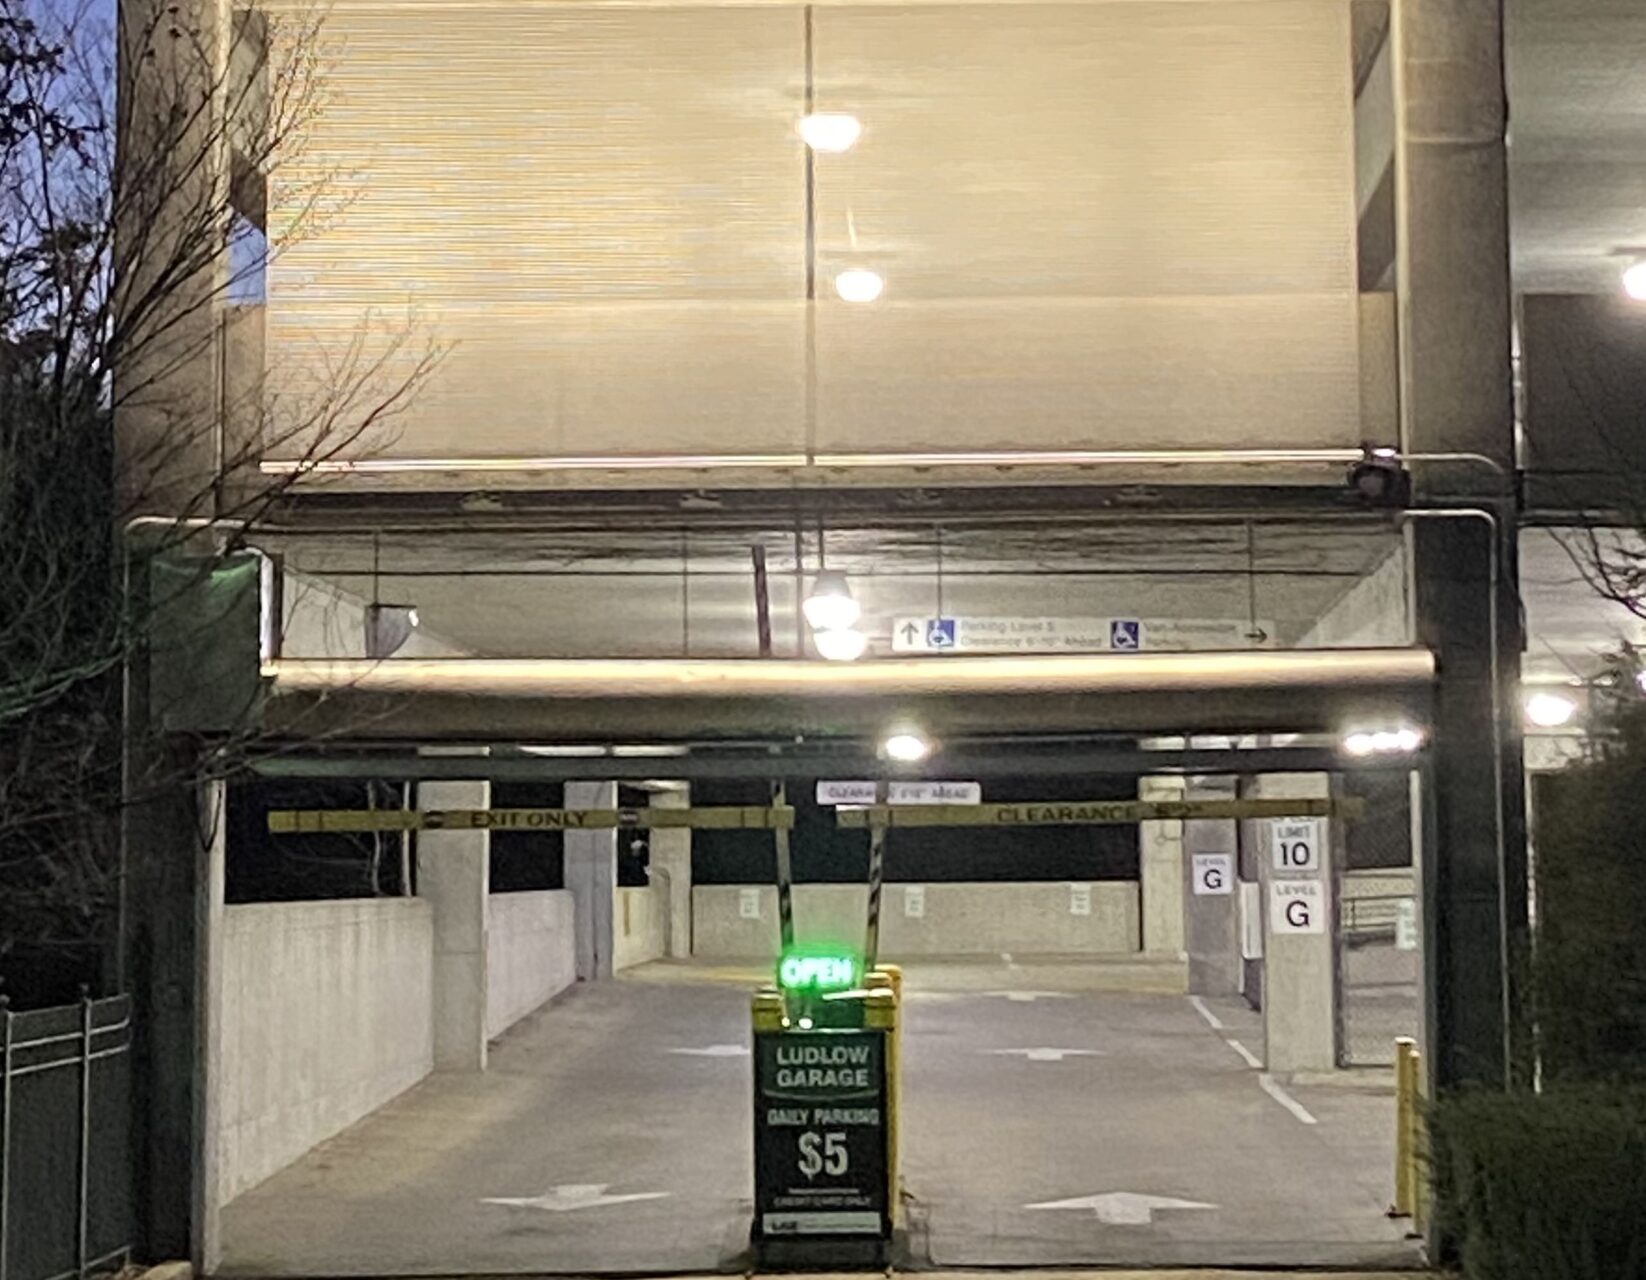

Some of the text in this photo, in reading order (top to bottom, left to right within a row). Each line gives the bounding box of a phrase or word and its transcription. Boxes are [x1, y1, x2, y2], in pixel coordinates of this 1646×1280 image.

[471, 811, 588, 827] EXIT ONLY
[997, 805, 1134, 822] CLEARANCE
[1277, 825, 1311, 839] LIMIT
[1280, 841, 1310, 866] 10
[1203, 868, 1223, 890] G
[1276, 884, 1317, 896] LEVEL
[1285, 899, 1310, 928] G
[780, 956, 854, 988] OPEN
[776, 1046, 870, 1065] LUDLOW
[776, 1069, 869, 1087] GARAGE
[767, 1108, 880, 1126] DAILY PARKING
[798, 1130, 848, 1181] $5
